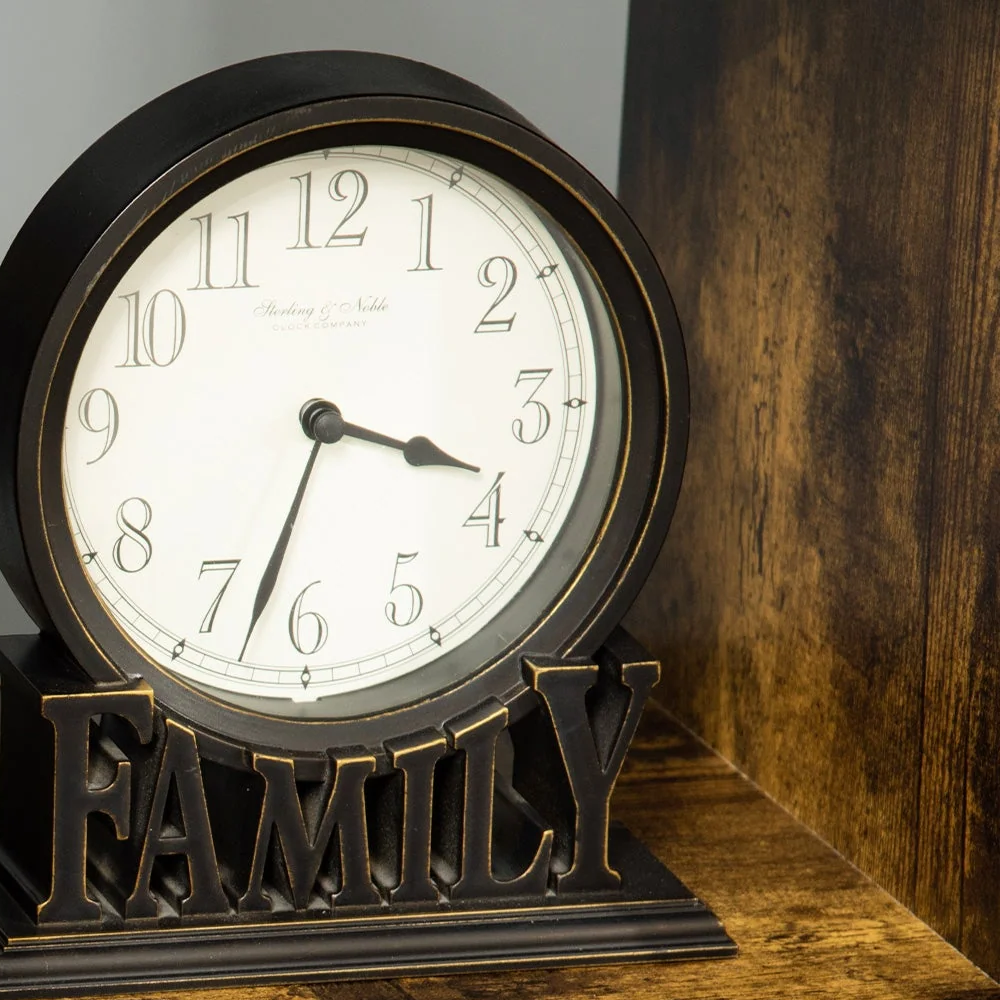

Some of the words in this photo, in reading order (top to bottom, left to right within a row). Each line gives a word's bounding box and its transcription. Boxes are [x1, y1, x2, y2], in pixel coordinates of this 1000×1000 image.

[285, 168, 368, 250] 12
[407, 194, 443, 272] 1
[187, 211, 260, 291] 11
[115, 289, 187, 368] 10
[253, 299, 315, 322] Sterling
[339, 295, 389, 314] Noble
[313, 319, 368, 330] COMPANY
[474, 256, 517, 334] 2
[78, 388, 119, 465] 9
[512, 368, 553, 444] 3
[113, 497, 152, 573] 8
[462, 471, 506, 548] 4
[198, 559, 242, 633] 7
[288, 580, 328, 655] 6
[385, 552, 423, 627] 5
[37, 659, 662, 926] FAMILY
